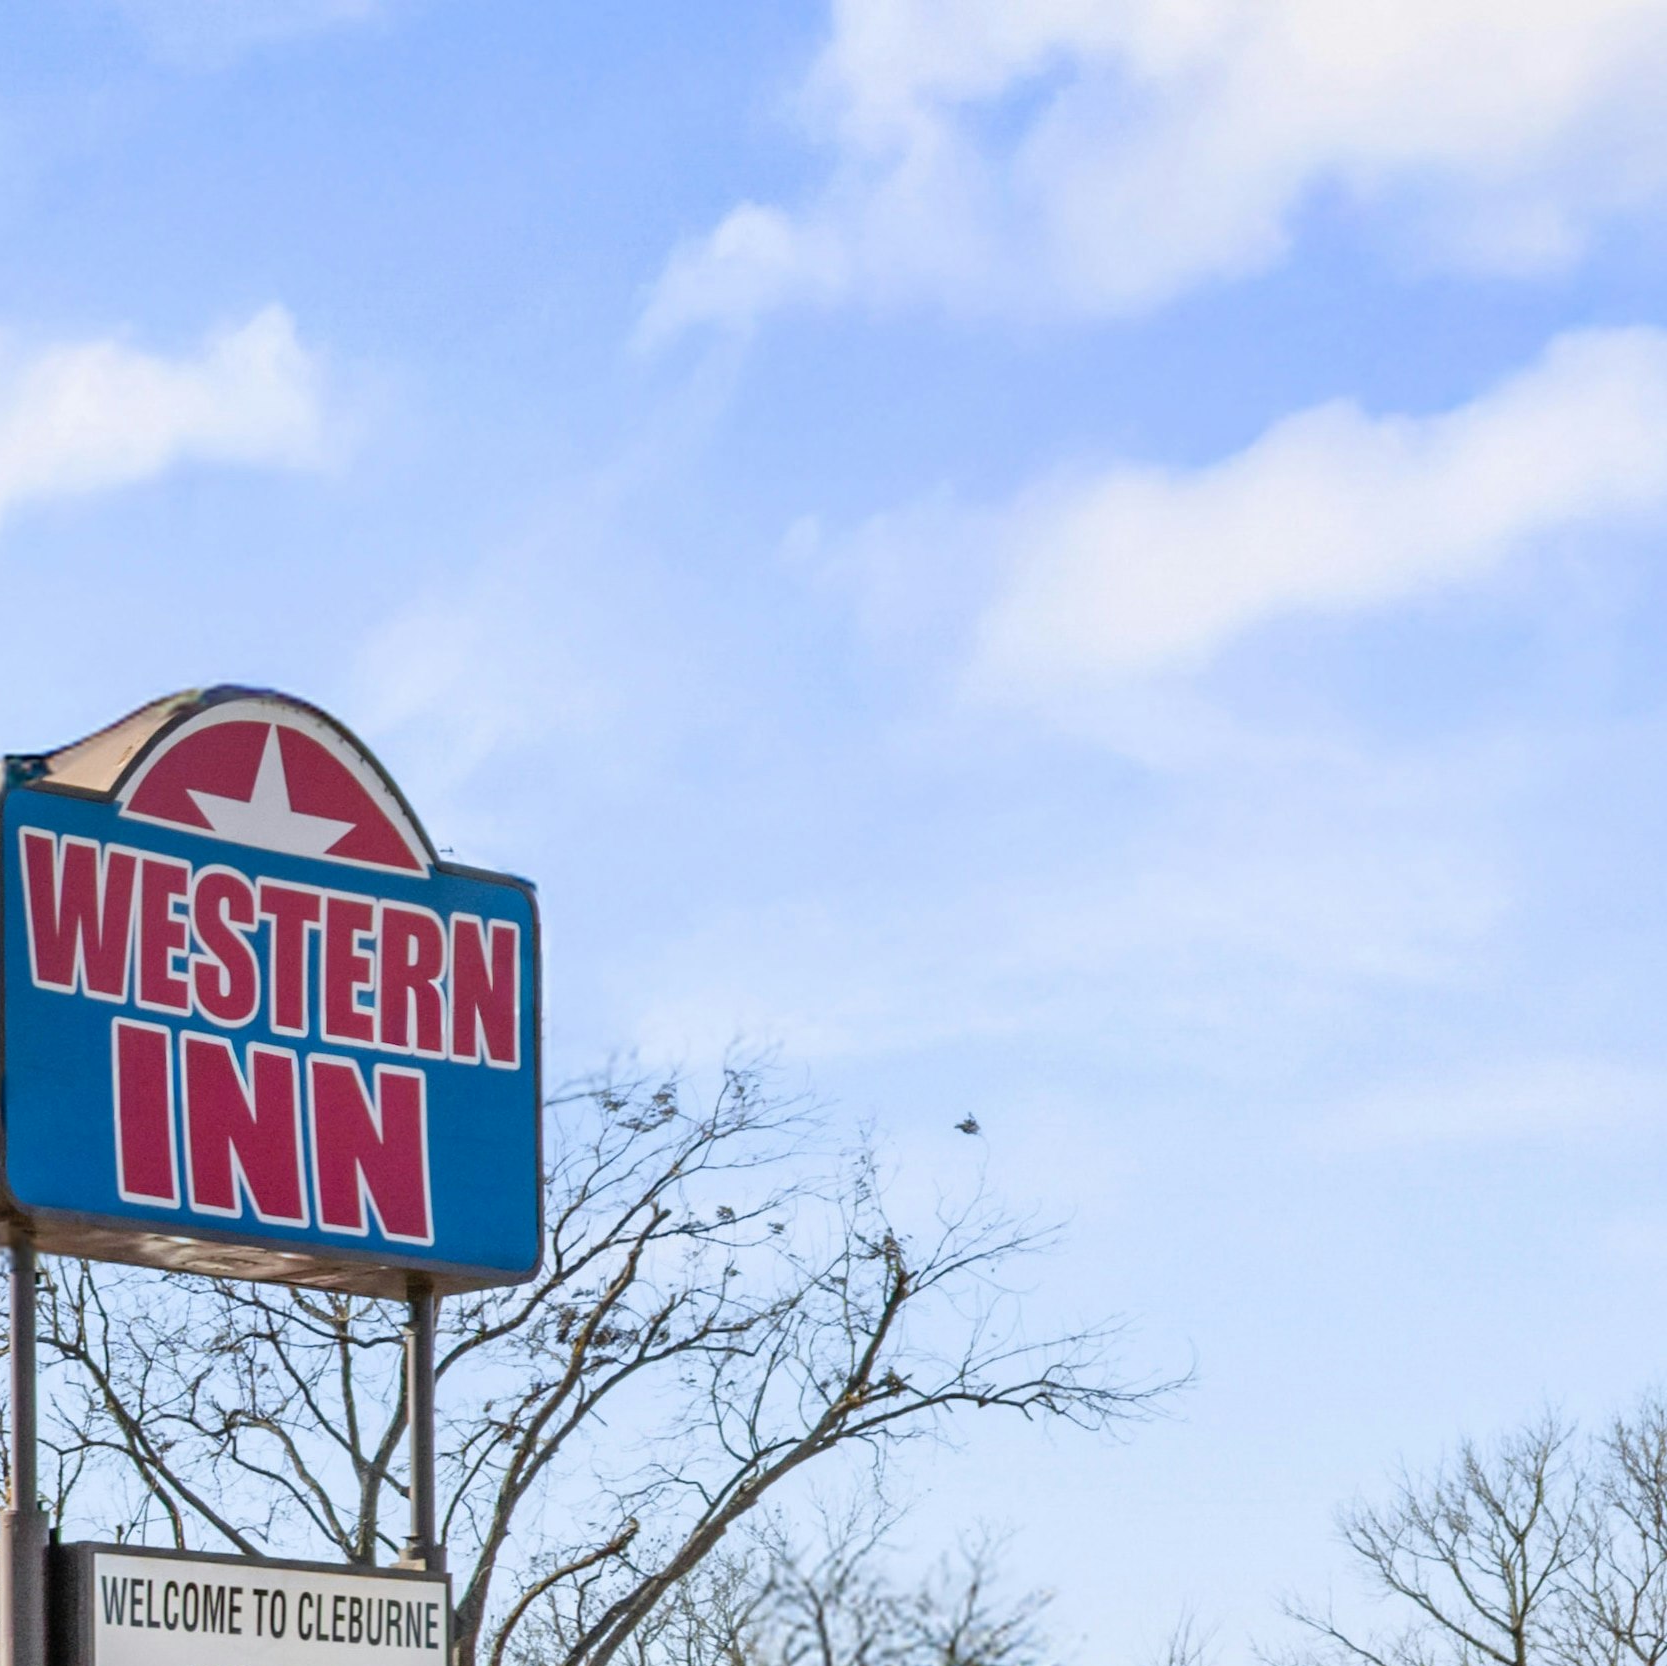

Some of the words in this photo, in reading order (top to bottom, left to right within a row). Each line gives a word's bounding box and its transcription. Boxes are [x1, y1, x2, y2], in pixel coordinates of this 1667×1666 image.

[18, 825, 520, 1069] WESTERN
[111, 1016, 434, 1246] INN
[101, 1575, 242, 1635] WELCOME
[253, 1588, 287, 1639] TO
[298, 1591, 439, 1650] CLEBURNE
